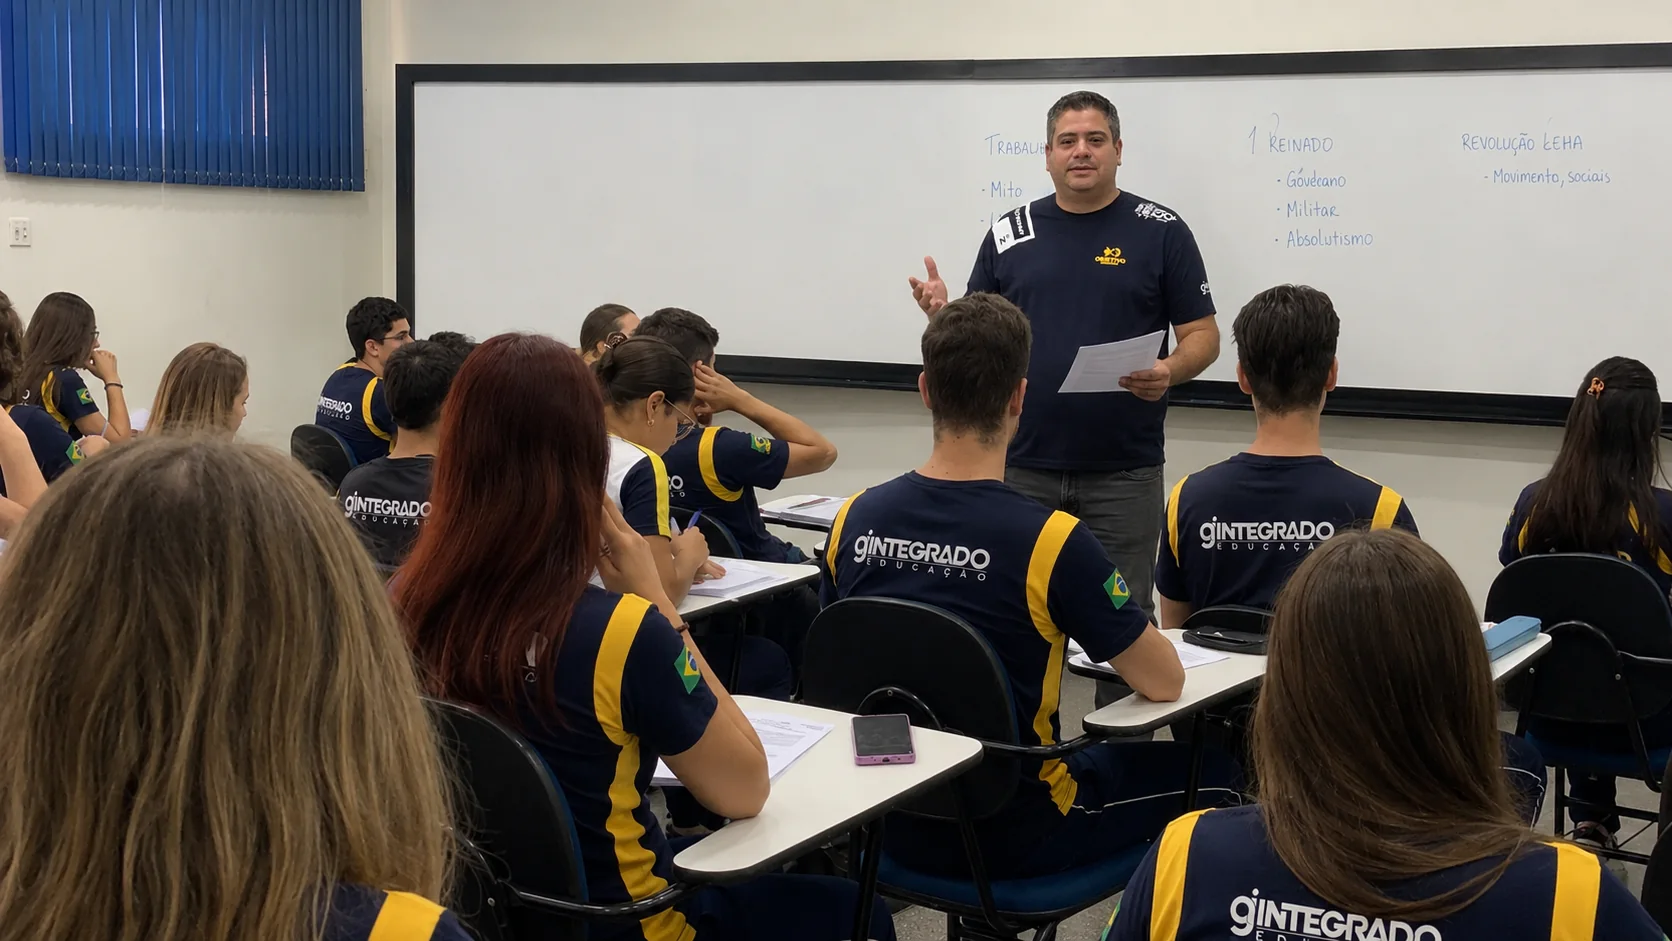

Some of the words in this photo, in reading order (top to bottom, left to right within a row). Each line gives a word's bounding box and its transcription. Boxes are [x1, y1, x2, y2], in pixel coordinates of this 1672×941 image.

[1269, 124, 1334, 153] REINADO
[1461, 132, 1536, 156] REVOLUÇÃO
[1568, 169, 1611, 184] sociais
[990, 180, 1023, 198] Mito
[1286, 199, 1340, 218] Militar
[1286, 229, 1374, 249] Absolutismo
